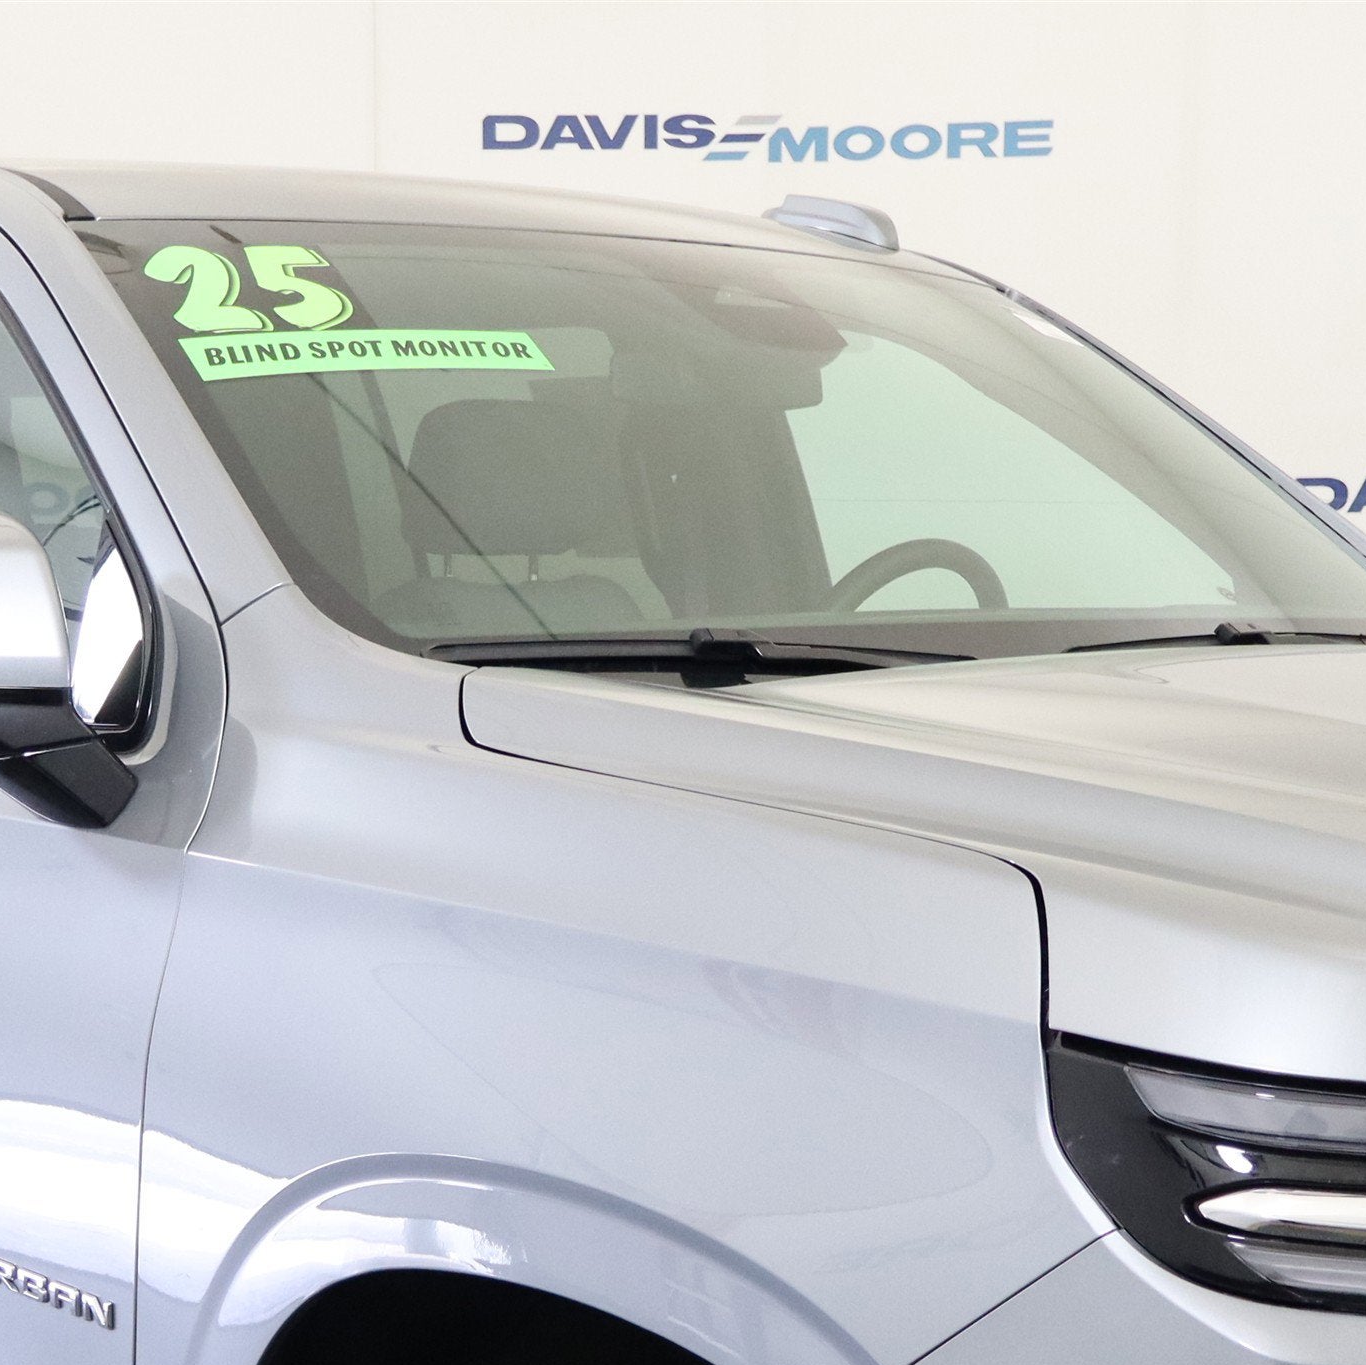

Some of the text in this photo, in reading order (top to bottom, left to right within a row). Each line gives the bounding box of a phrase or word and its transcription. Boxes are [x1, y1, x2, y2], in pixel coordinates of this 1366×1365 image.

[482, 114, 1054, 163] DAVIS MOORE
[143, 245, 354, 332] 25
[204, 339, 534, 366] BLIND SPOT MONITOR
